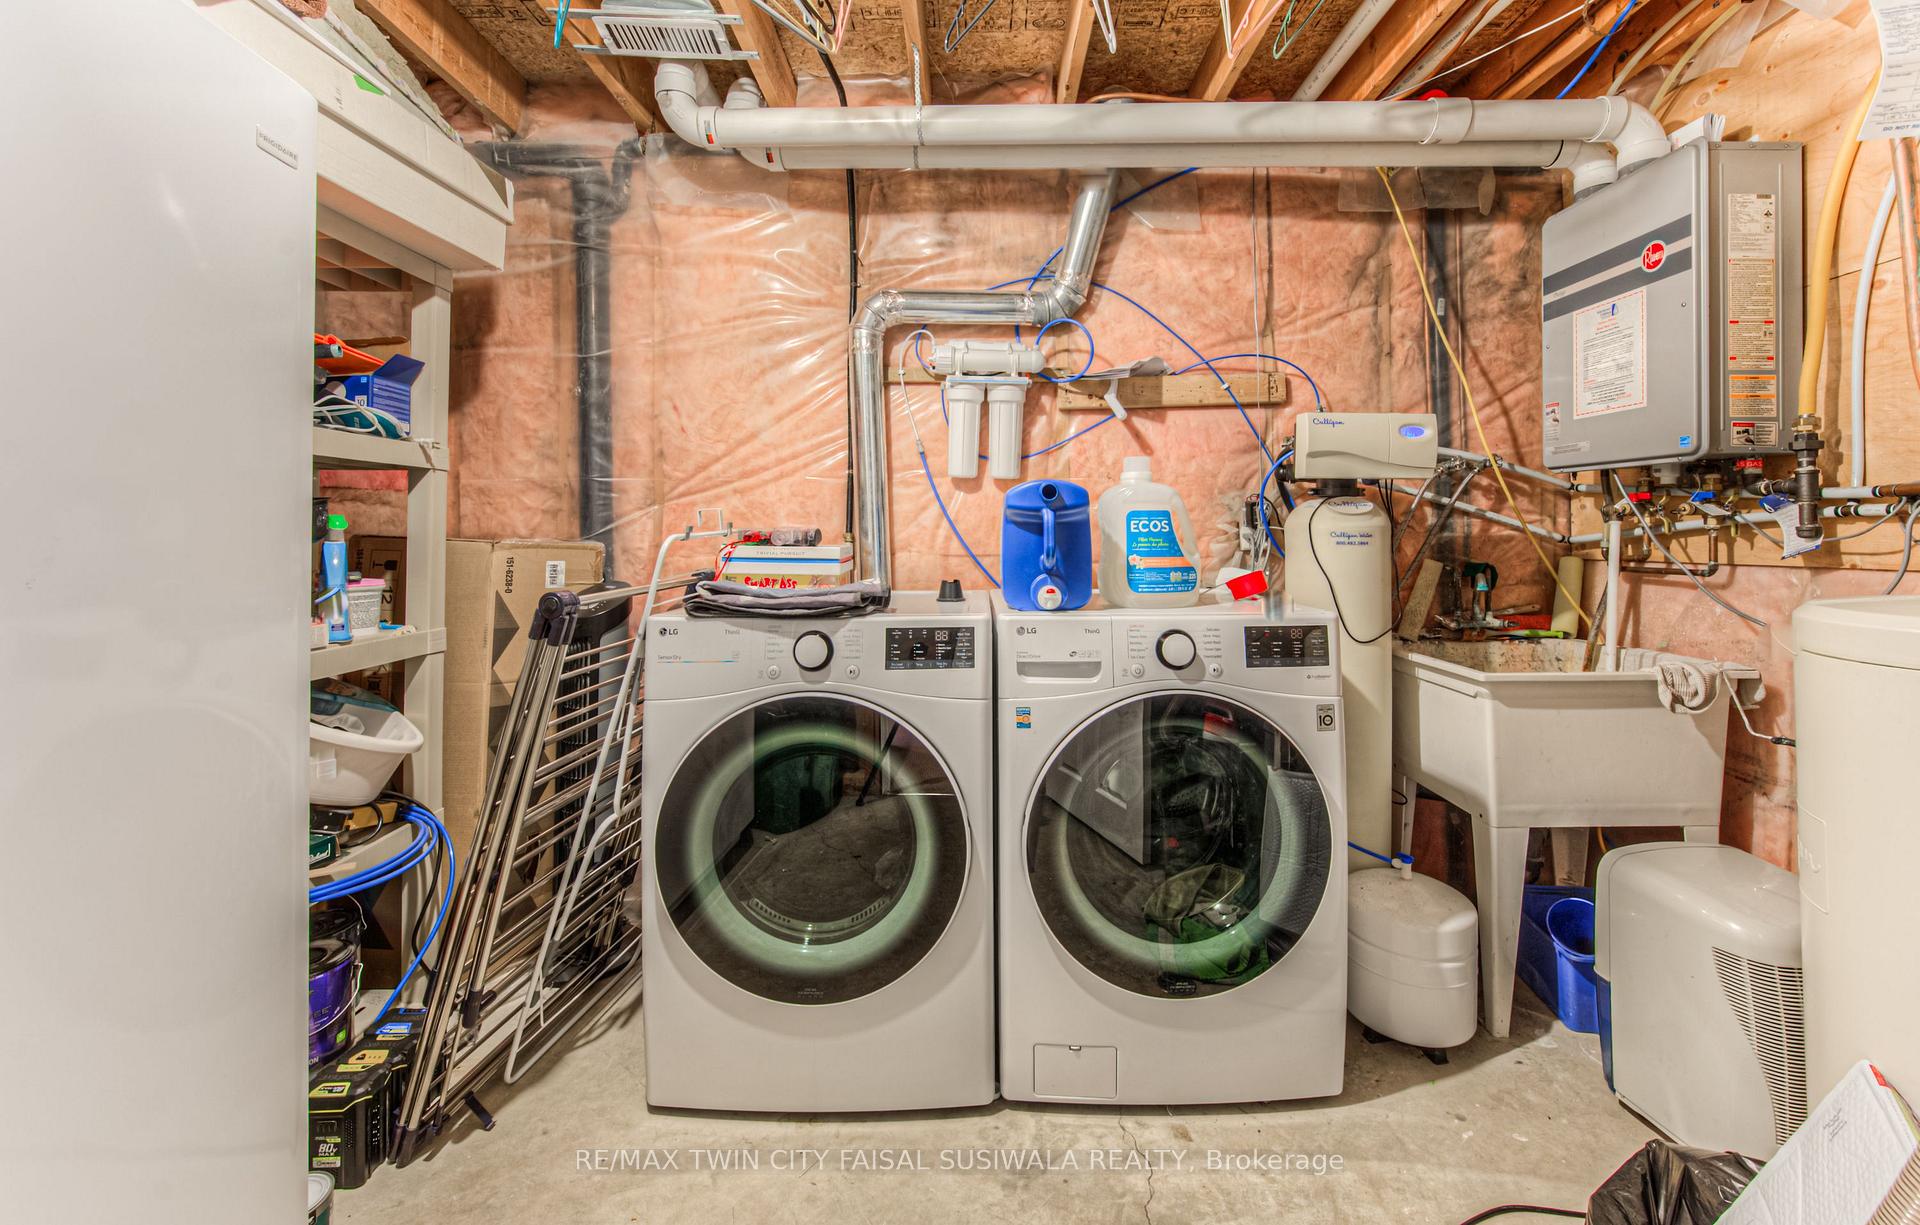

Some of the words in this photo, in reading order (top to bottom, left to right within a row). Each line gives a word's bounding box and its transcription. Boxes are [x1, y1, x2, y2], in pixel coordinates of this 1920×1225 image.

[258, 131, 298, 161] FRIGIDAIRE
[1312, 417, 1345, 428] Culligan
[1130, 520, 1170, 533] ECOS
[381, 586, 394, 605] 12
[668, 628, 679, 636] LG
[1026, 627, 1037, 635] LG
